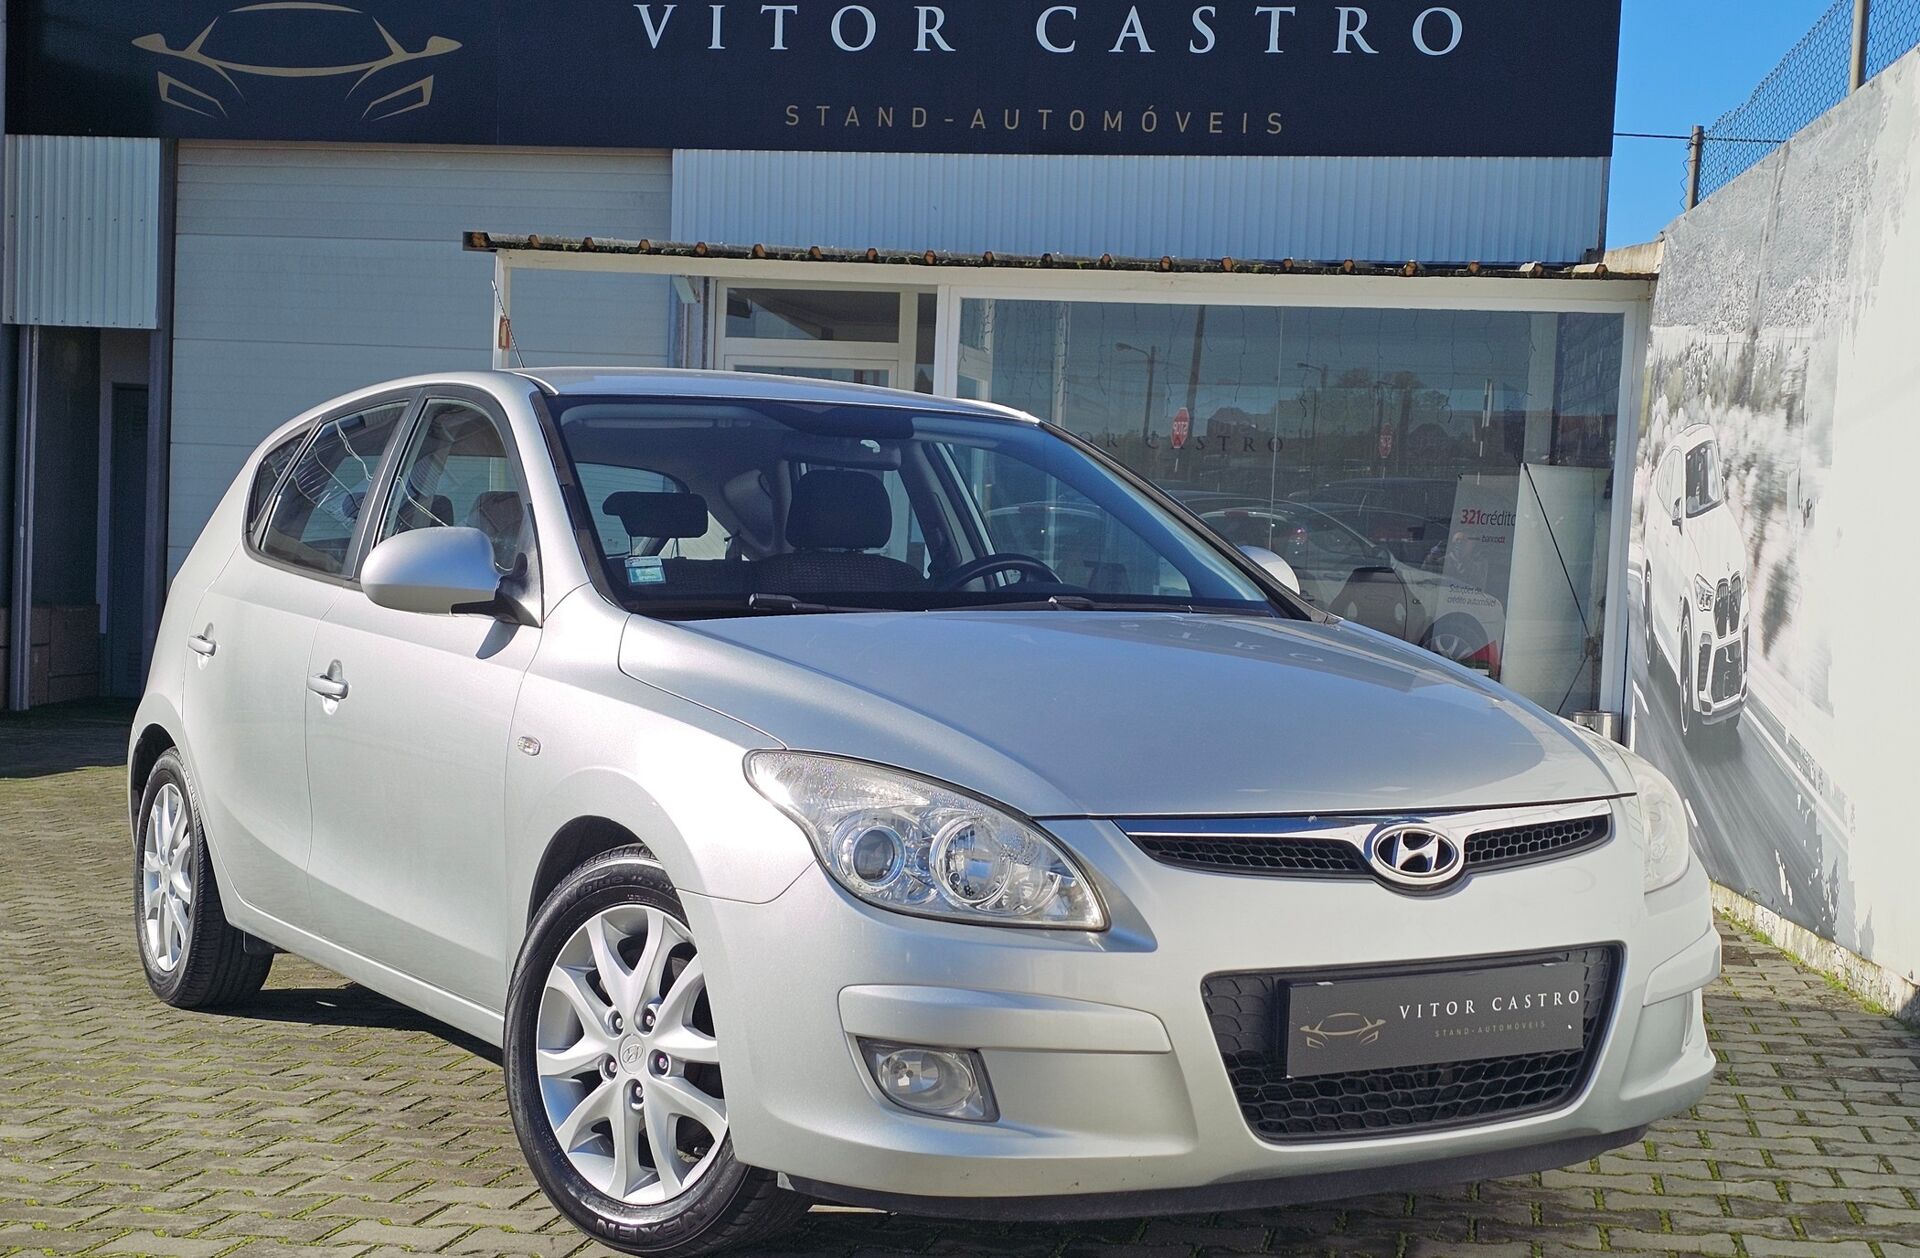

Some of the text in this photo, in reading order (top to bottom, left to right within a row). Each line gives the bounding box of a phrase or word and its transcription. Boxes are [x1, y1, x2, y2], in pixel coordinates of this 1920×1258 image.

[633, 4, 1464, 57] VITOR CASTRO
[784, 104, 1285, 135] STAND-AUTOMÓVEIS
[1399, 990, 1580, 1020] VITOR CASTRO
[1434, 1021, 1546, 1037] STAND-AUTOMÓVEIS
[596, 1210, 706, 1241] NEXEN
